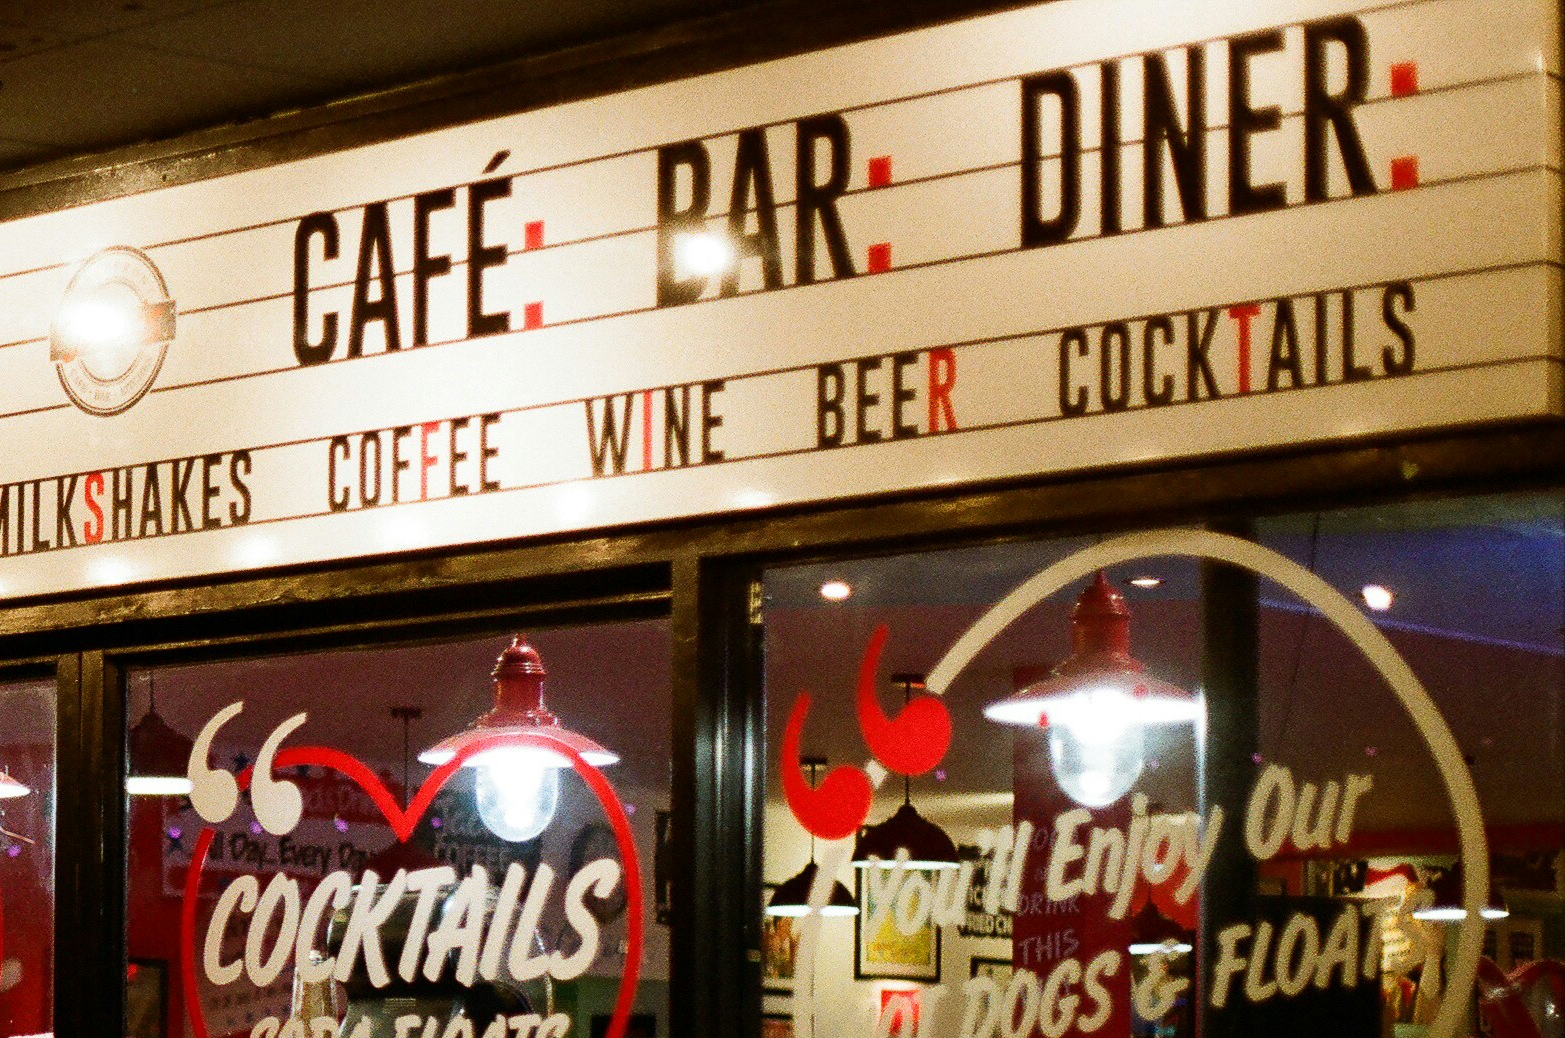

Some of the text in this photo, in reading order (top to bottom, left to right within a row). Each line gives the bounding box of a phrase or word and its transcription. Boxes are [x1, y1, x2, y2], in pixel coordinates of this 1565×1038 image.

[328, 413, 502, 513] COFFEE
[585, 379, 726, 477] WINE
[816, 347, 958, 448] BEER
[1059, 281, 1417, 418] COCKTAILS
[1047, 791, 1225, 922] Enjoy
[1245, 763, 1374, 861] Our
[202, 857, 623, 990] COCKTAILS
[1018, 928, 1080, 966] THIS
[1134, 937, 1192, 1022] &
